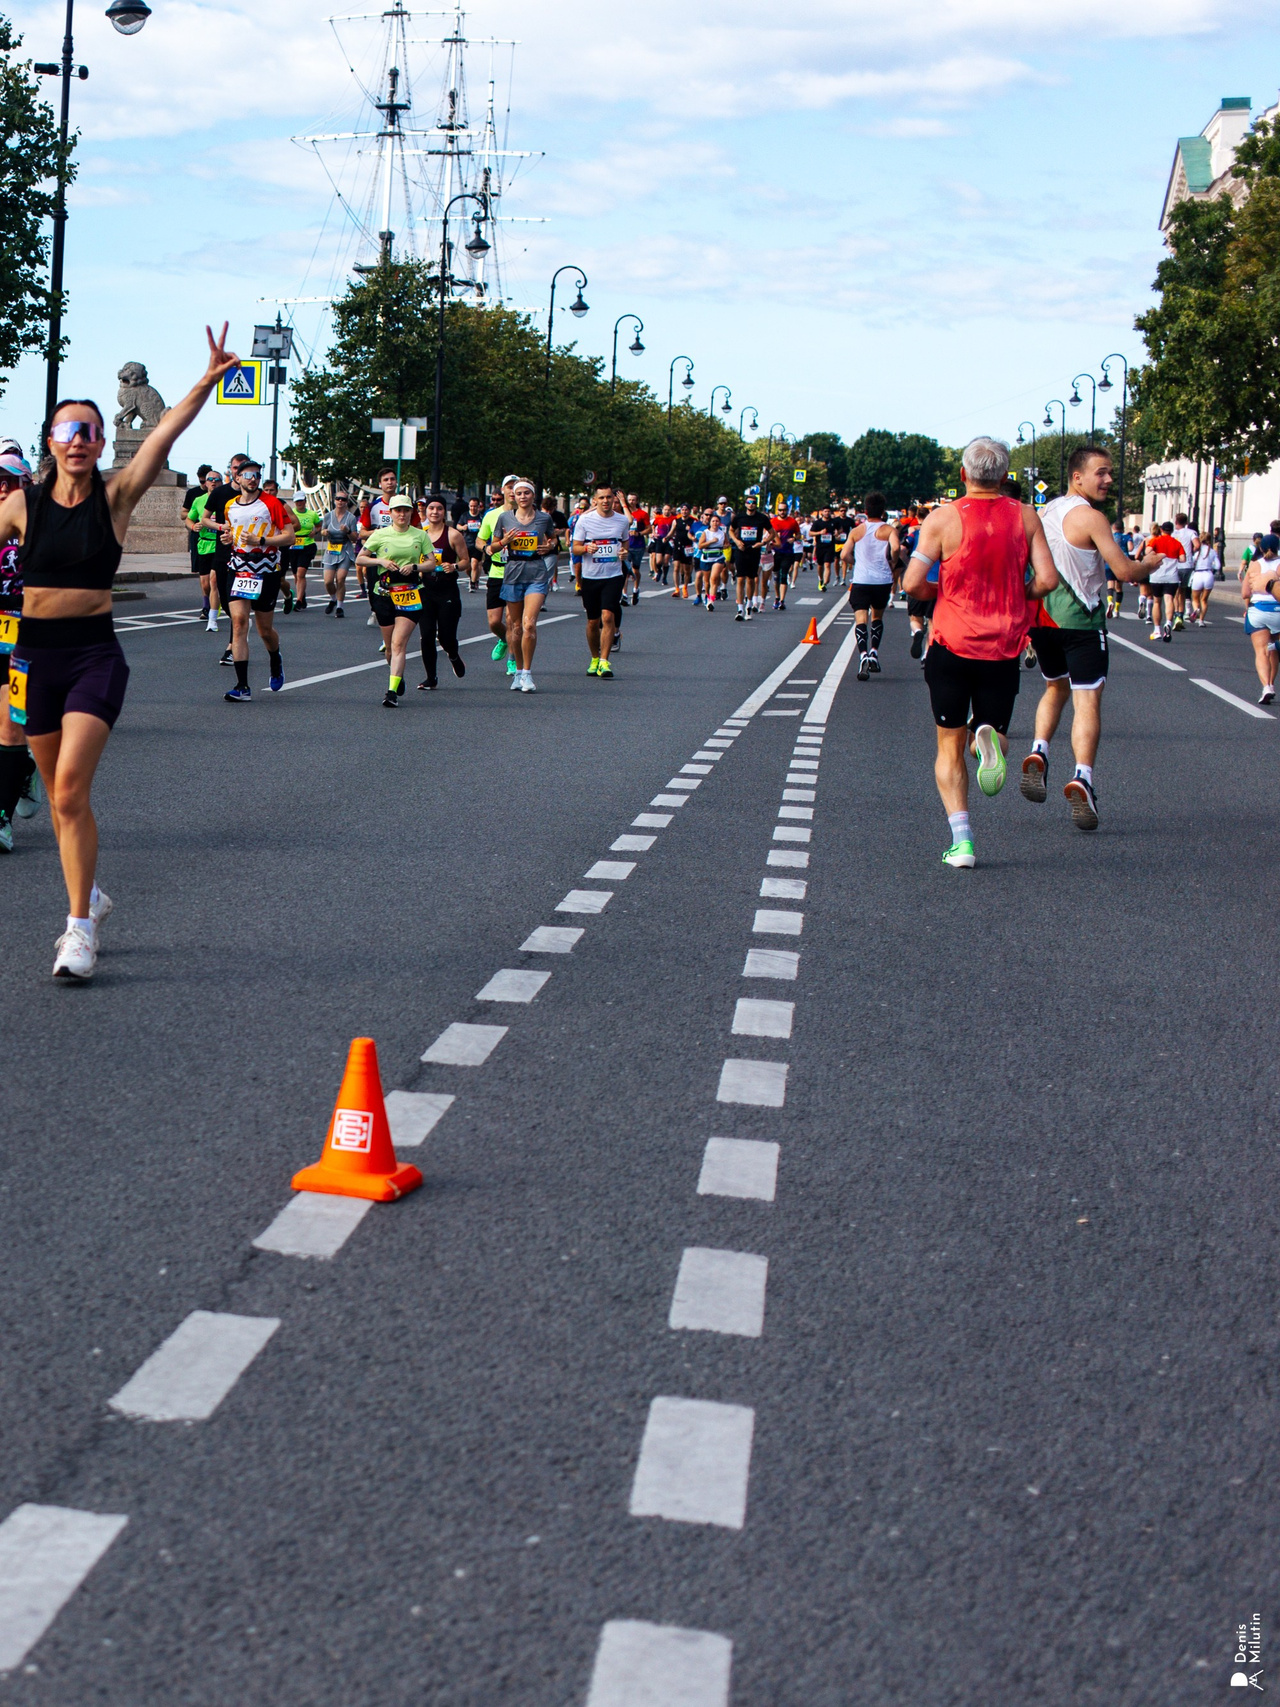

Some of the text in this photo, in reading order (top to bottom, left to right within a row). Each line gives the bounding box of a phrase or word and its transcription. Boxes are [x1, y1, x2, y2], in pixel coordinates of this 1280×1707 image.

[513, 538, 535, 547] 6709
[237, 579, 259, 589] 3719
[394, 592, 416, 602] 3718
[9, 676, 19, 695] 6
